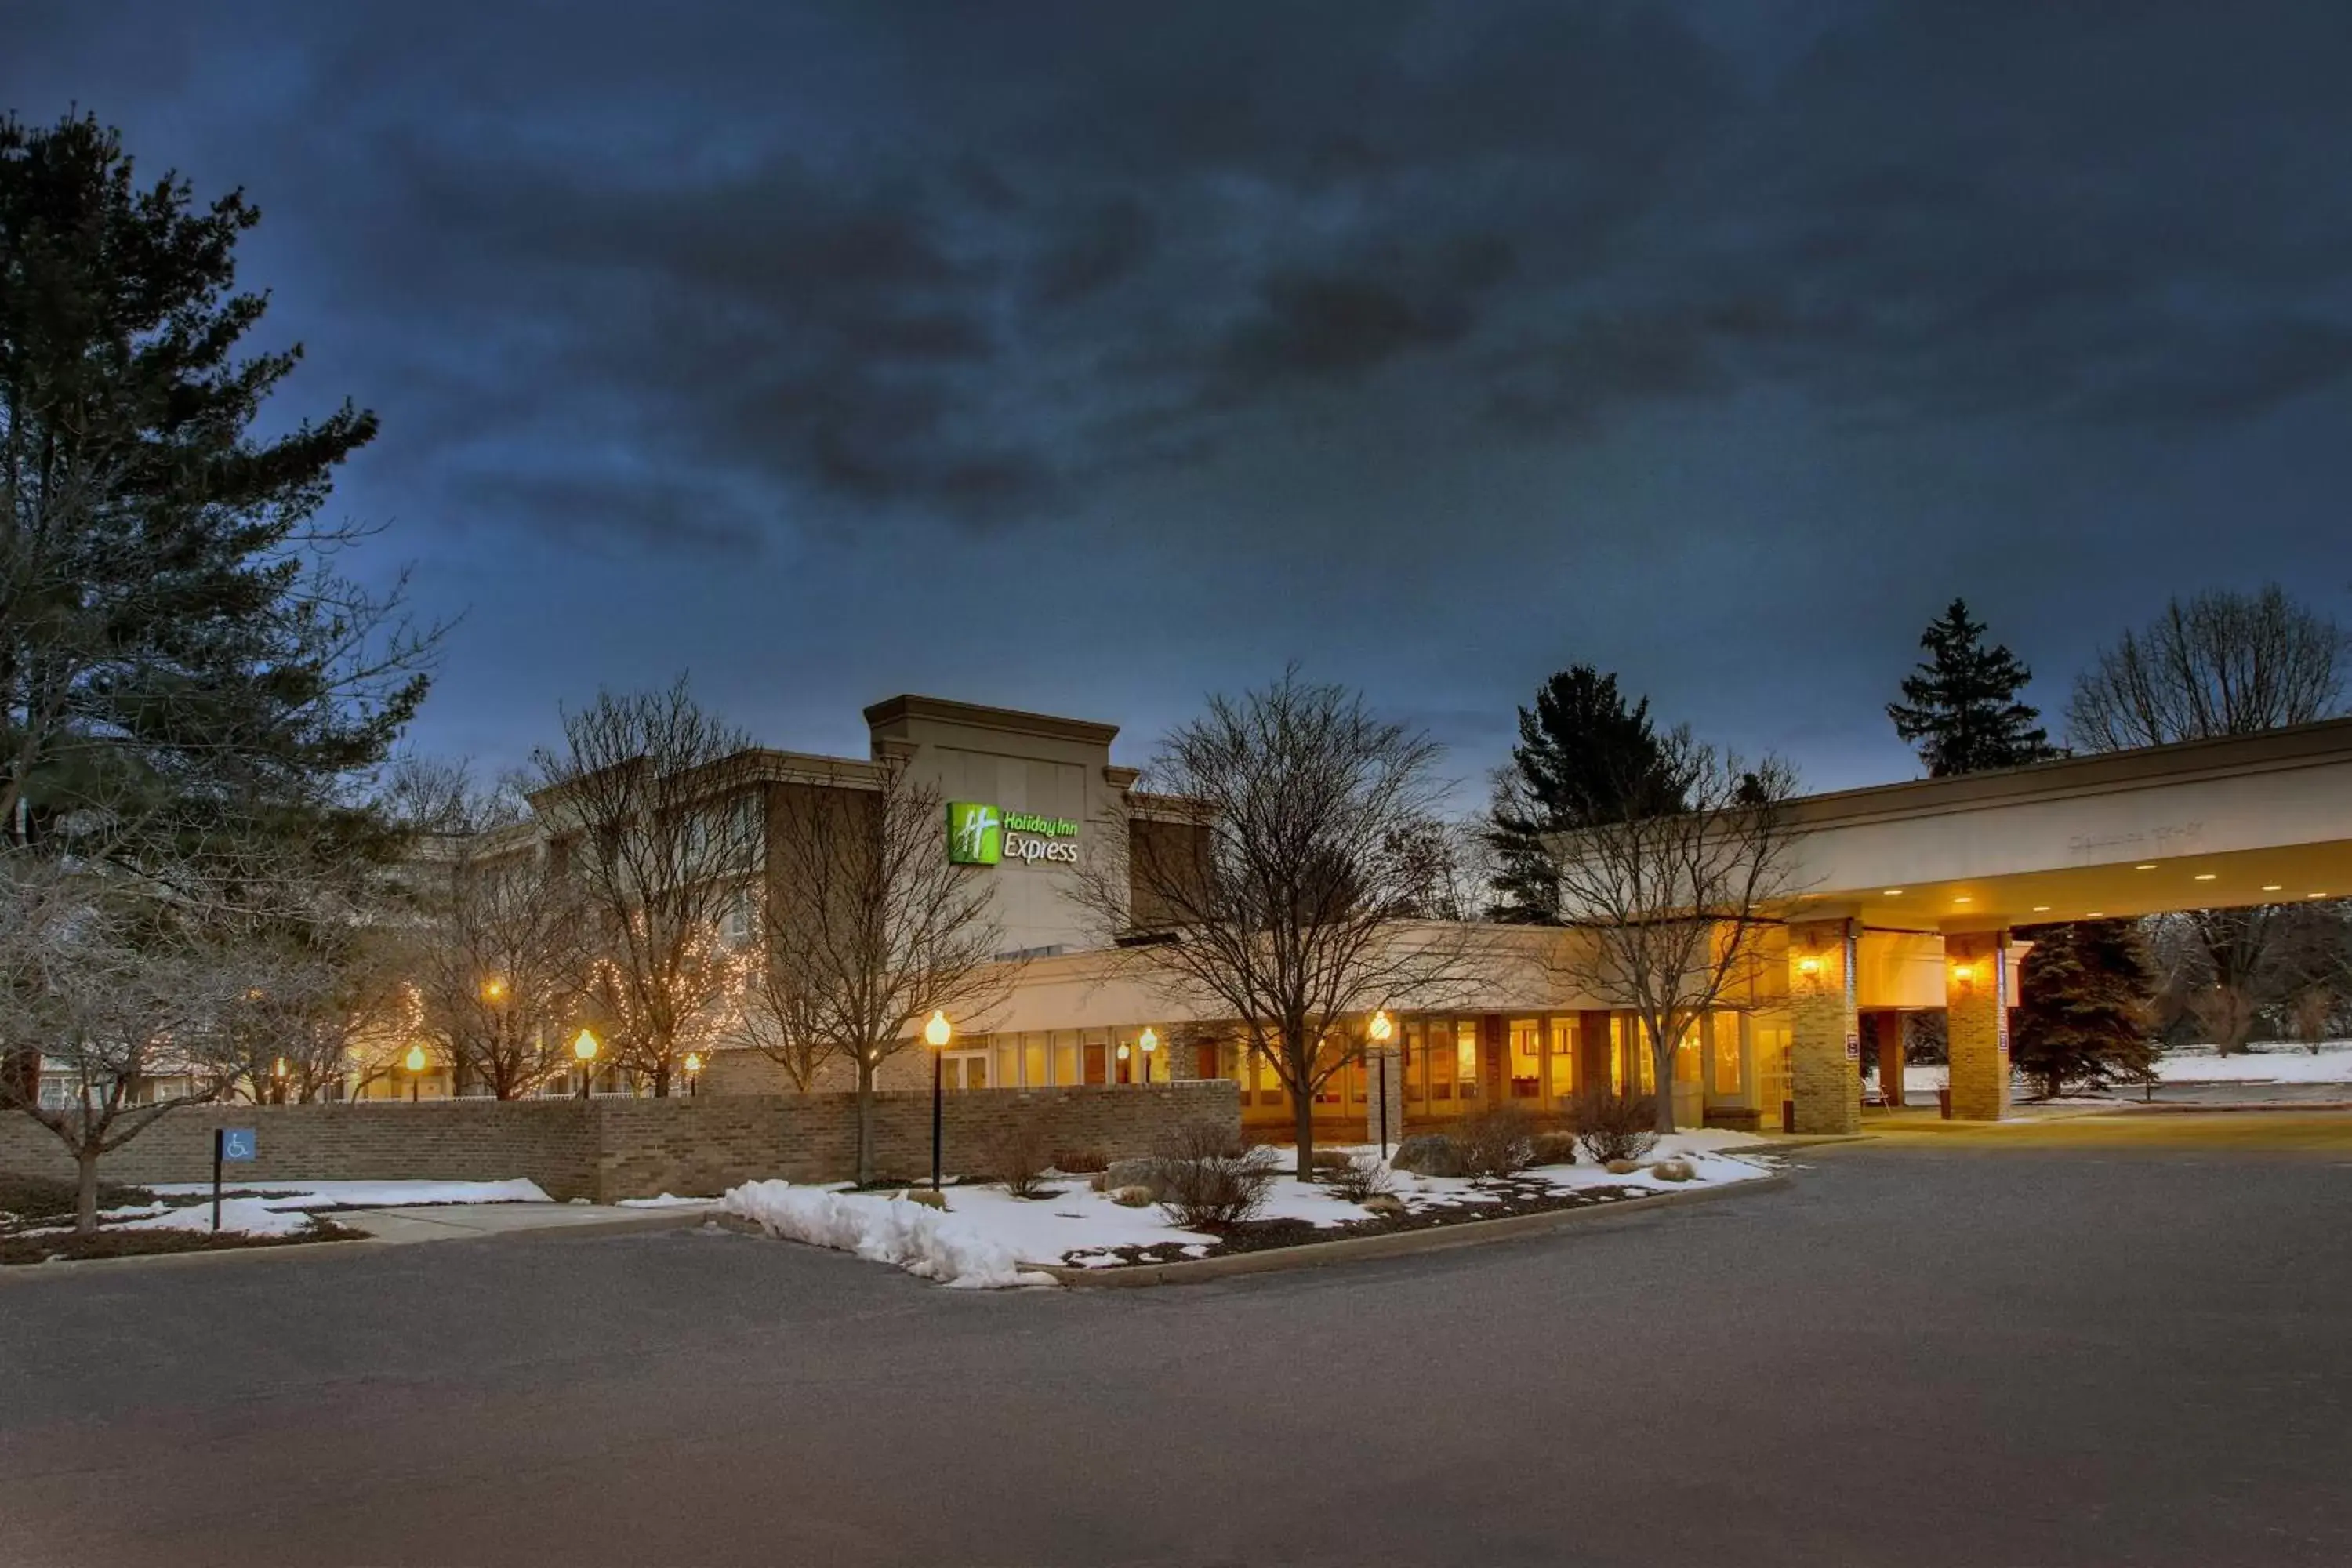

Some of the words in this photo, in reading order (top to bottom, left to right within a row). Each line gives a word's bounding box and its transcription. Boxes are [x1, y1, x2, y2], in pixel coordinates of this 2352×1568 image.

[1004, 811, 1057, 837] Holiday
[1057, 818, 1078, 836] Inn
[1004, 832, 1078, 865] Express
